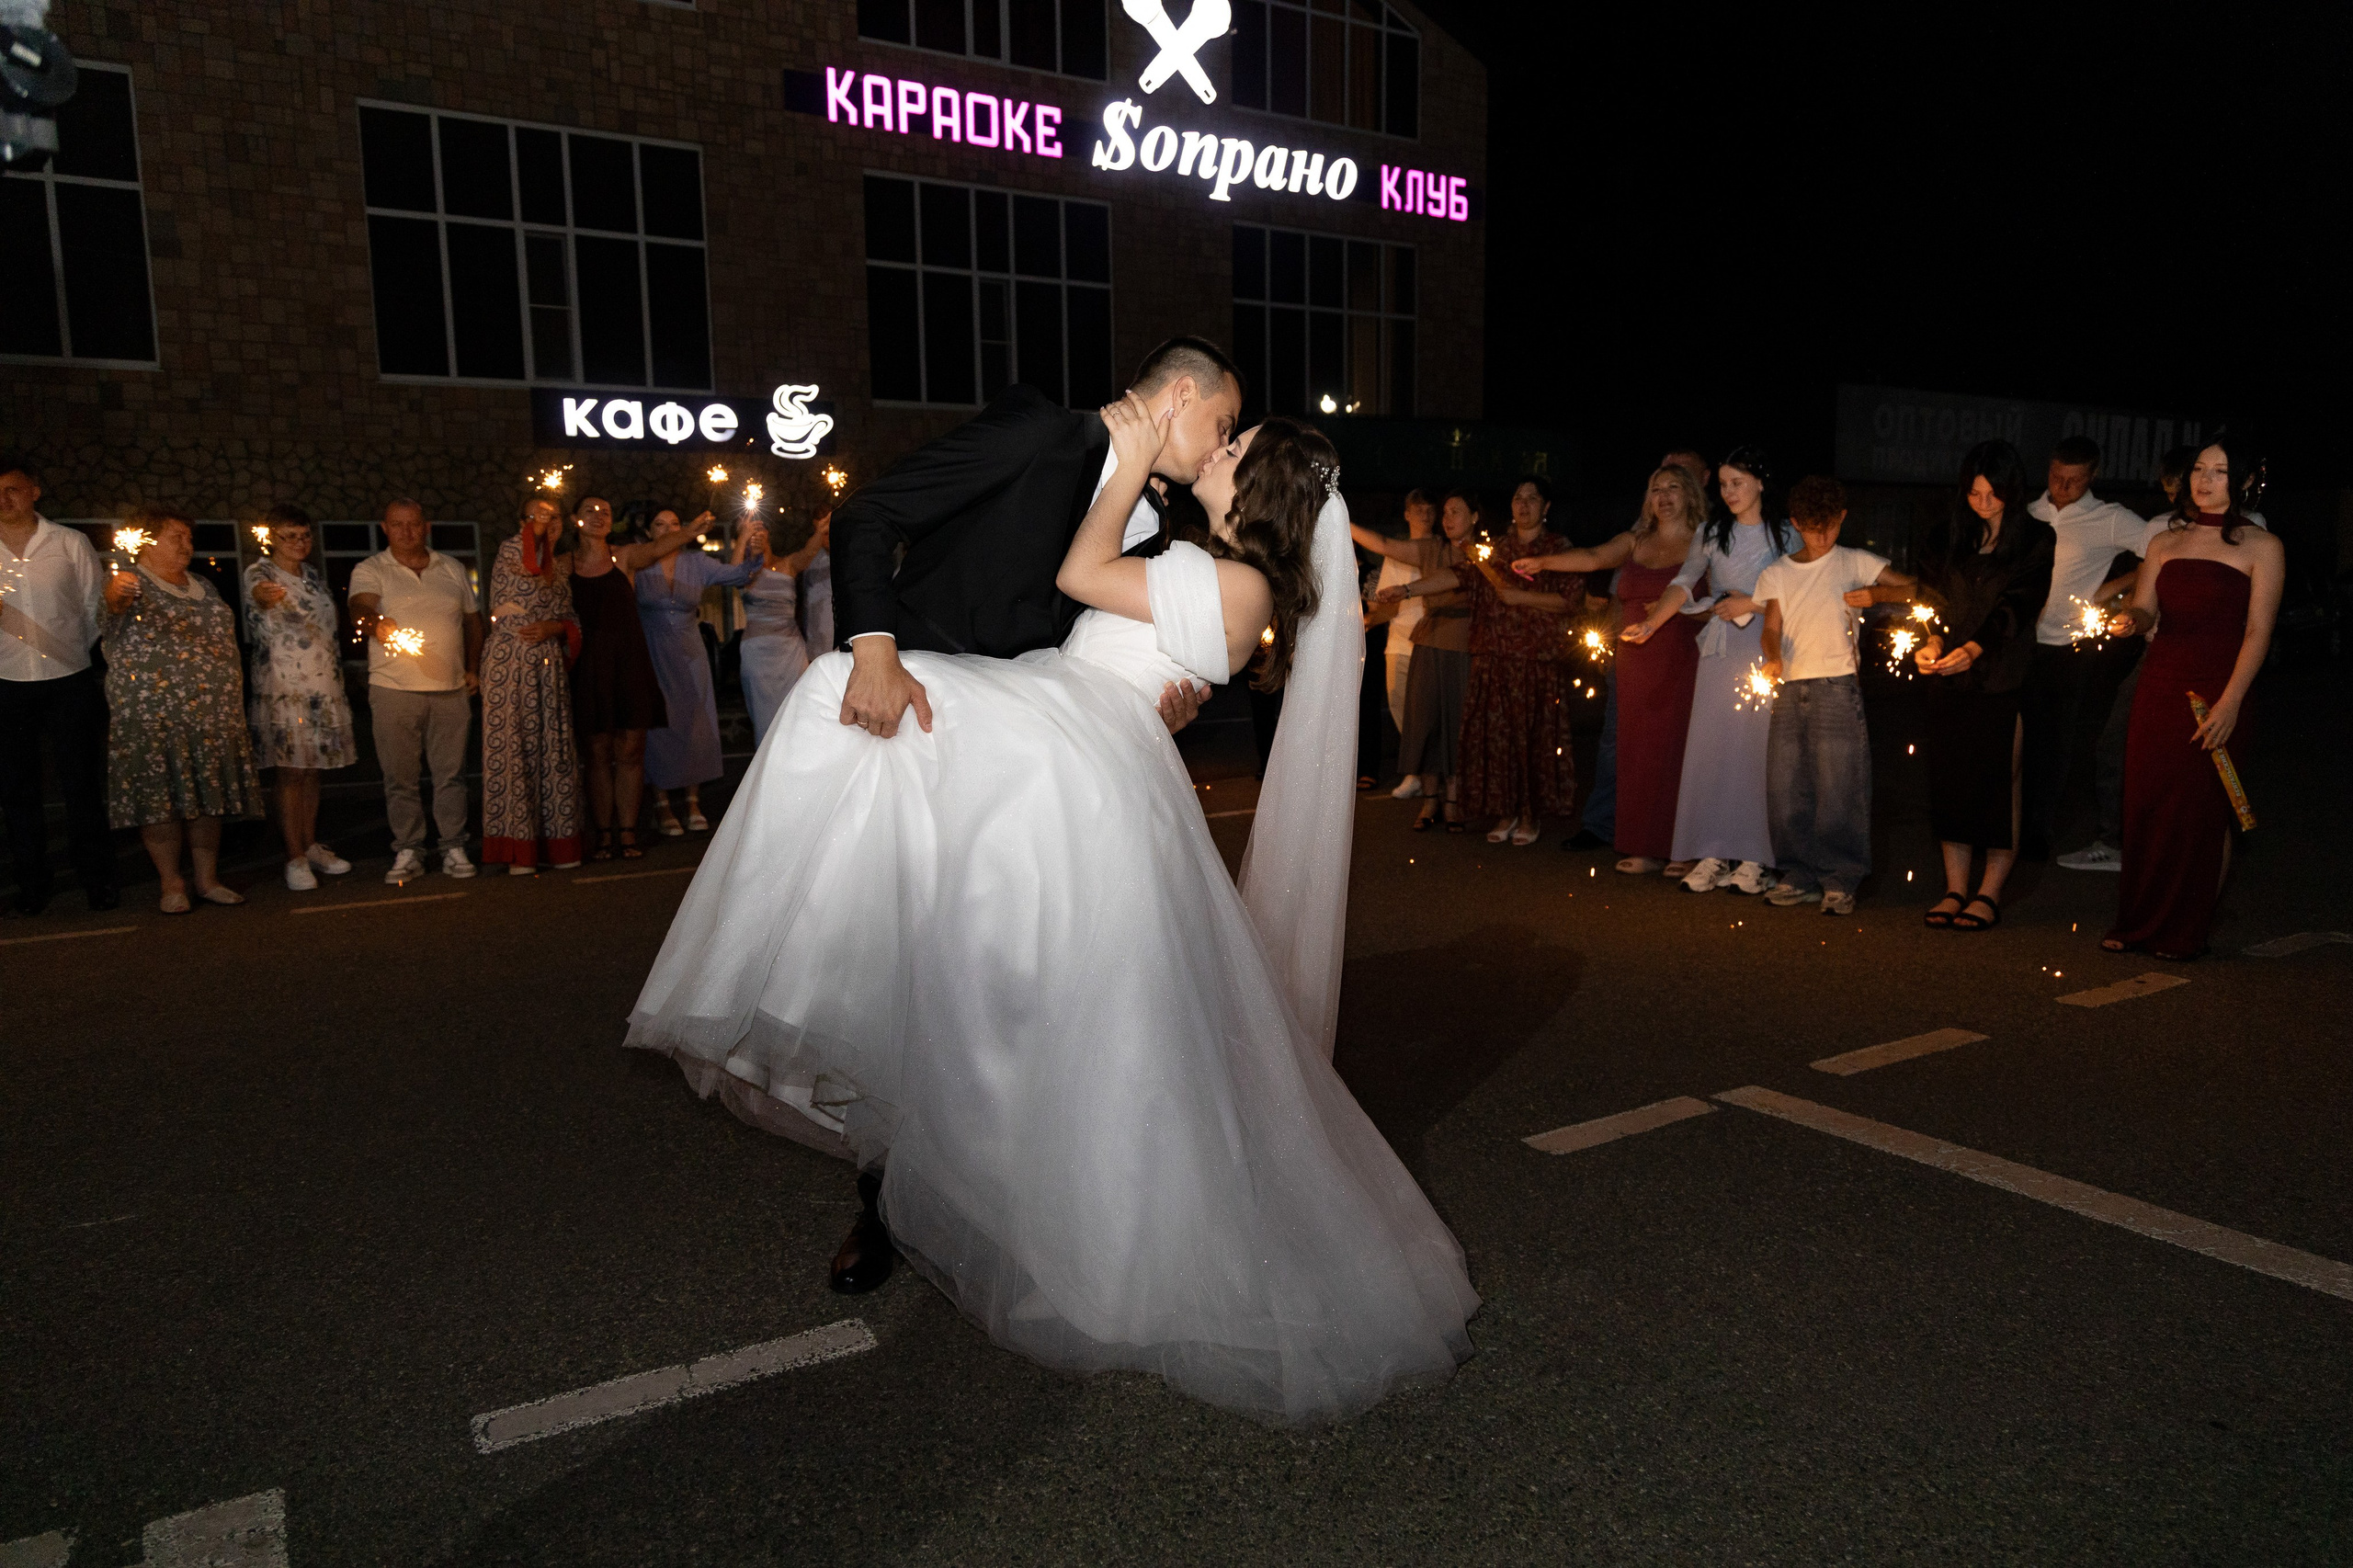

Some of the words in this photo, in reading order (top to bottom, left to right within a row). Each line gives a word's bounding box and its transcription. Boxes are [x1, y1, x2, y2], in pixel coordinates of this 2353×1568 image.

[826, 66, 1063, 158] КАРАОКЕ
[1381, 164, 1469, 222] КЛУБ
[563, 397, 738, 444] кафе
[1873, 403, 2023, 447] ОПТОВЫЙ
